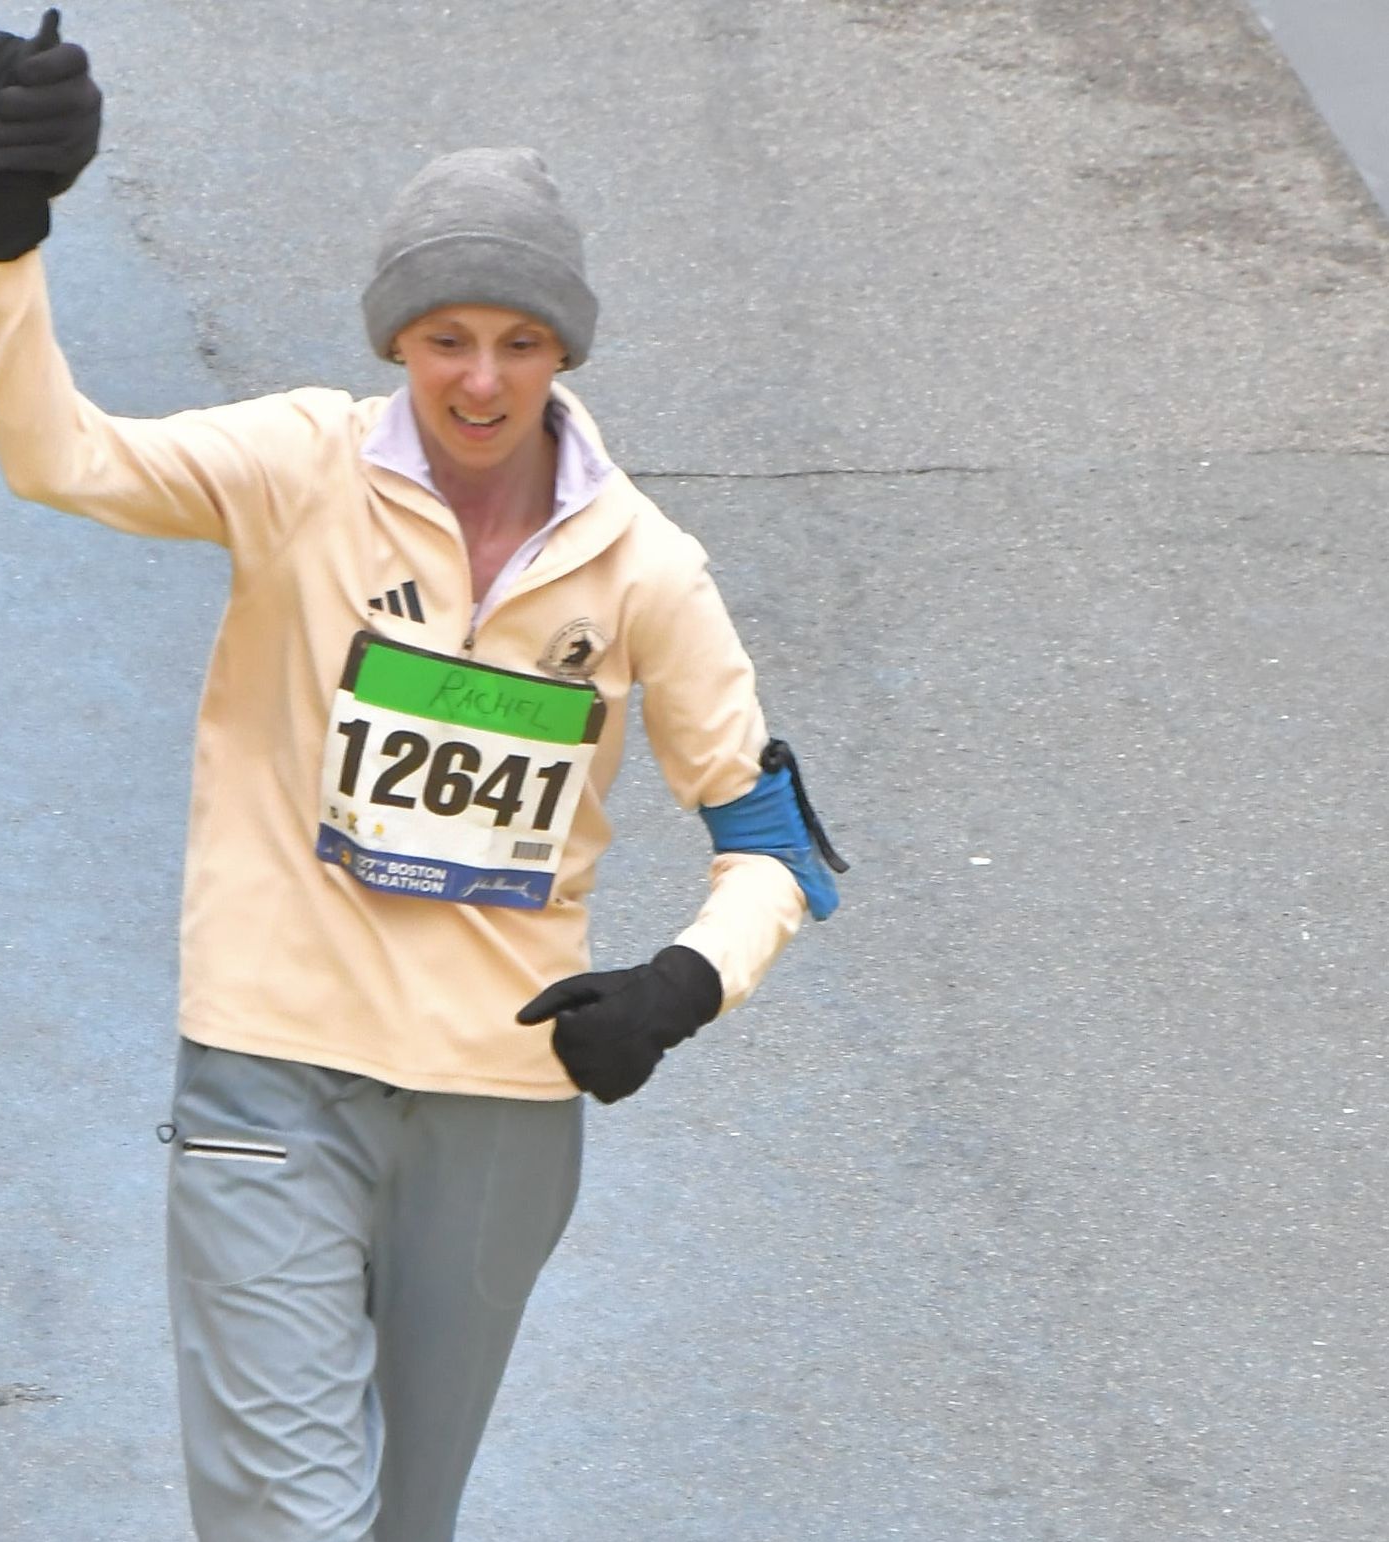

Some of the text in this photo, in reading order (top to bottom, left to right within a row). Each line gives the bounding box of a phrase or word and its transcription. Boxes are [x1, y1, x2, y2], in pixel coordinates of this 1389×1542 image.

[428, 670, 550, 732] RACHEL
[337, 718, 573, 831] 12641
[387, 861, 447, 880] BOSTON
